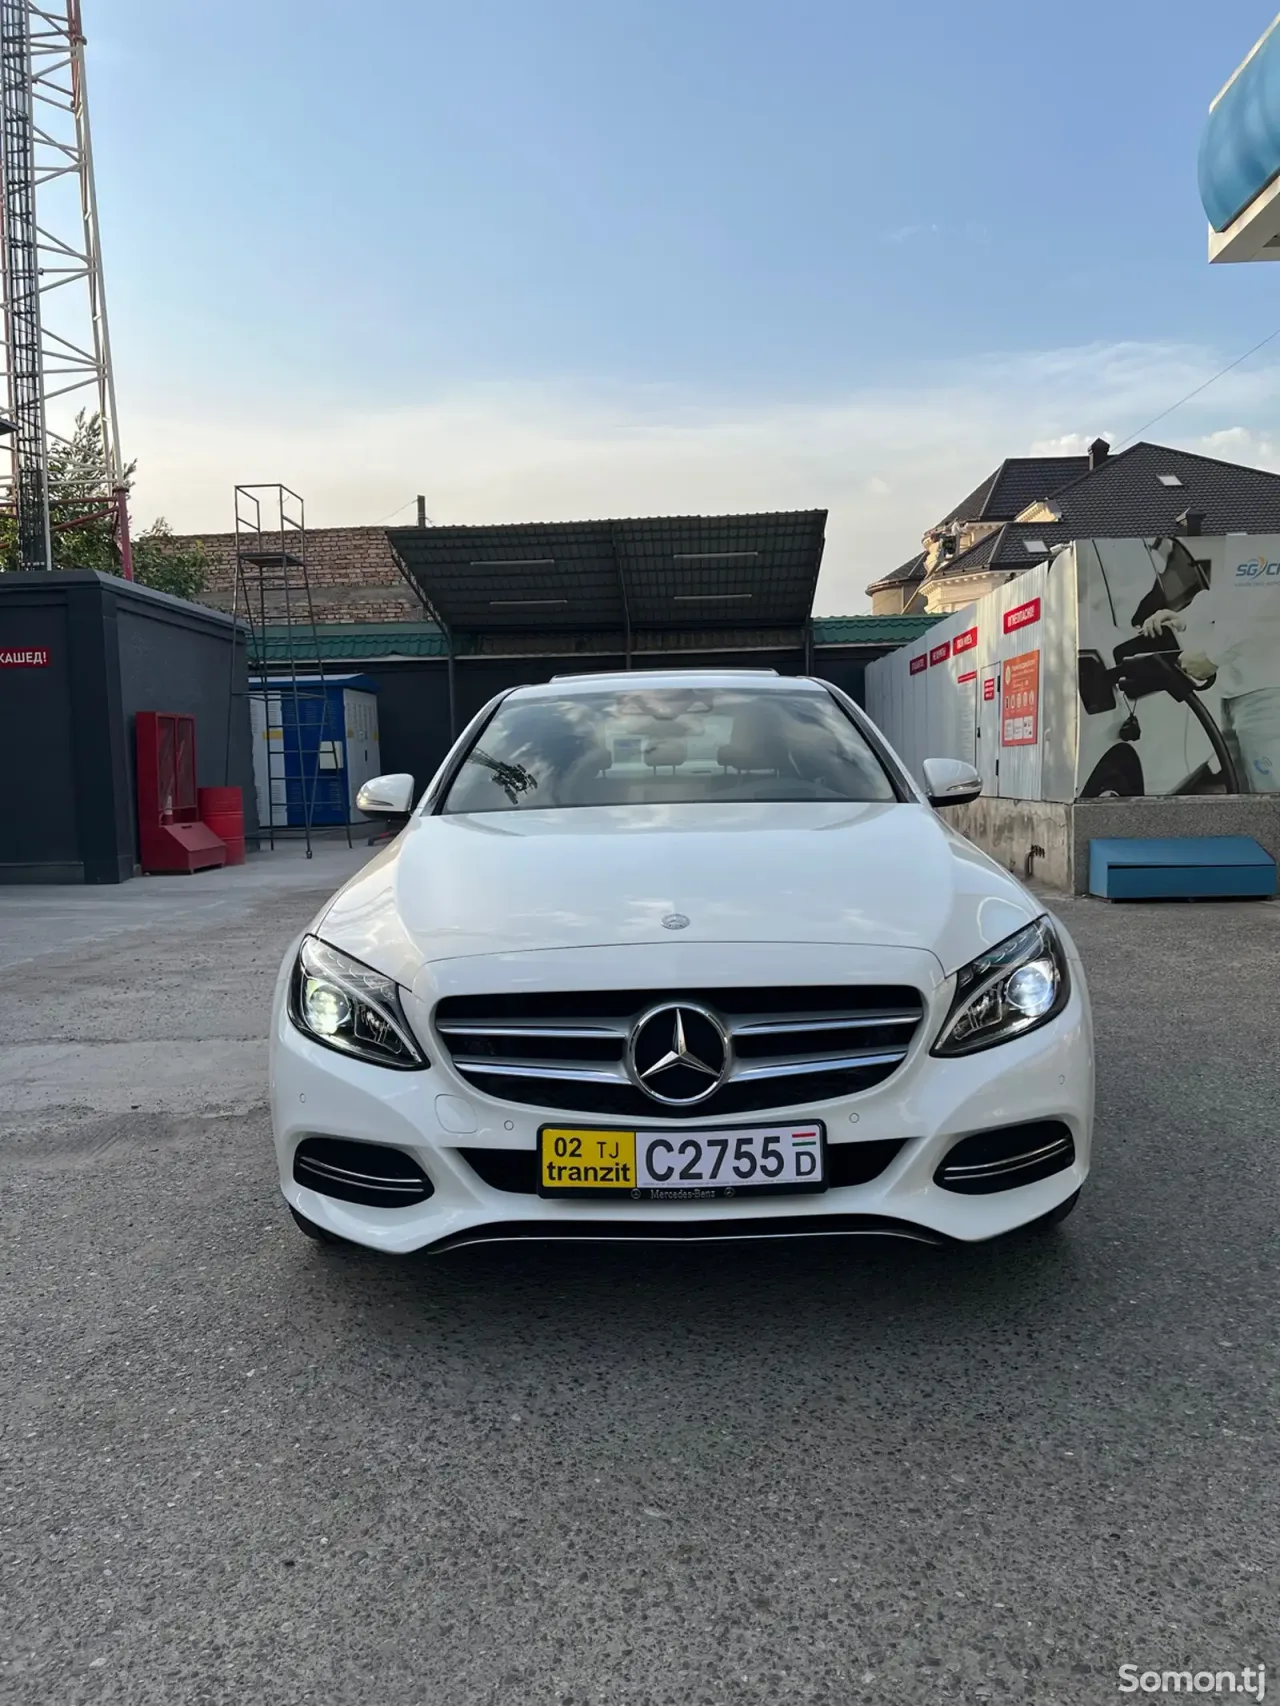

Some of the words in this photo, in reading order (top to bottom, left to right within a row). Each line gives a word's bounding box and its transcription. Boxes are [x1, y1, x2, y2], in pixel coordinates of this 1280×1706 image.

[554, 1137, 583, 1158] 02
[597, 1141, 619, 1159] TJ
[645, 1136, 784, 1181] C2755
[795, 1151, 817, 1177] D
[546, 1161, 630, 1182] tranzit
[650, 1188, 716, 1199] Mercedes-Benz
